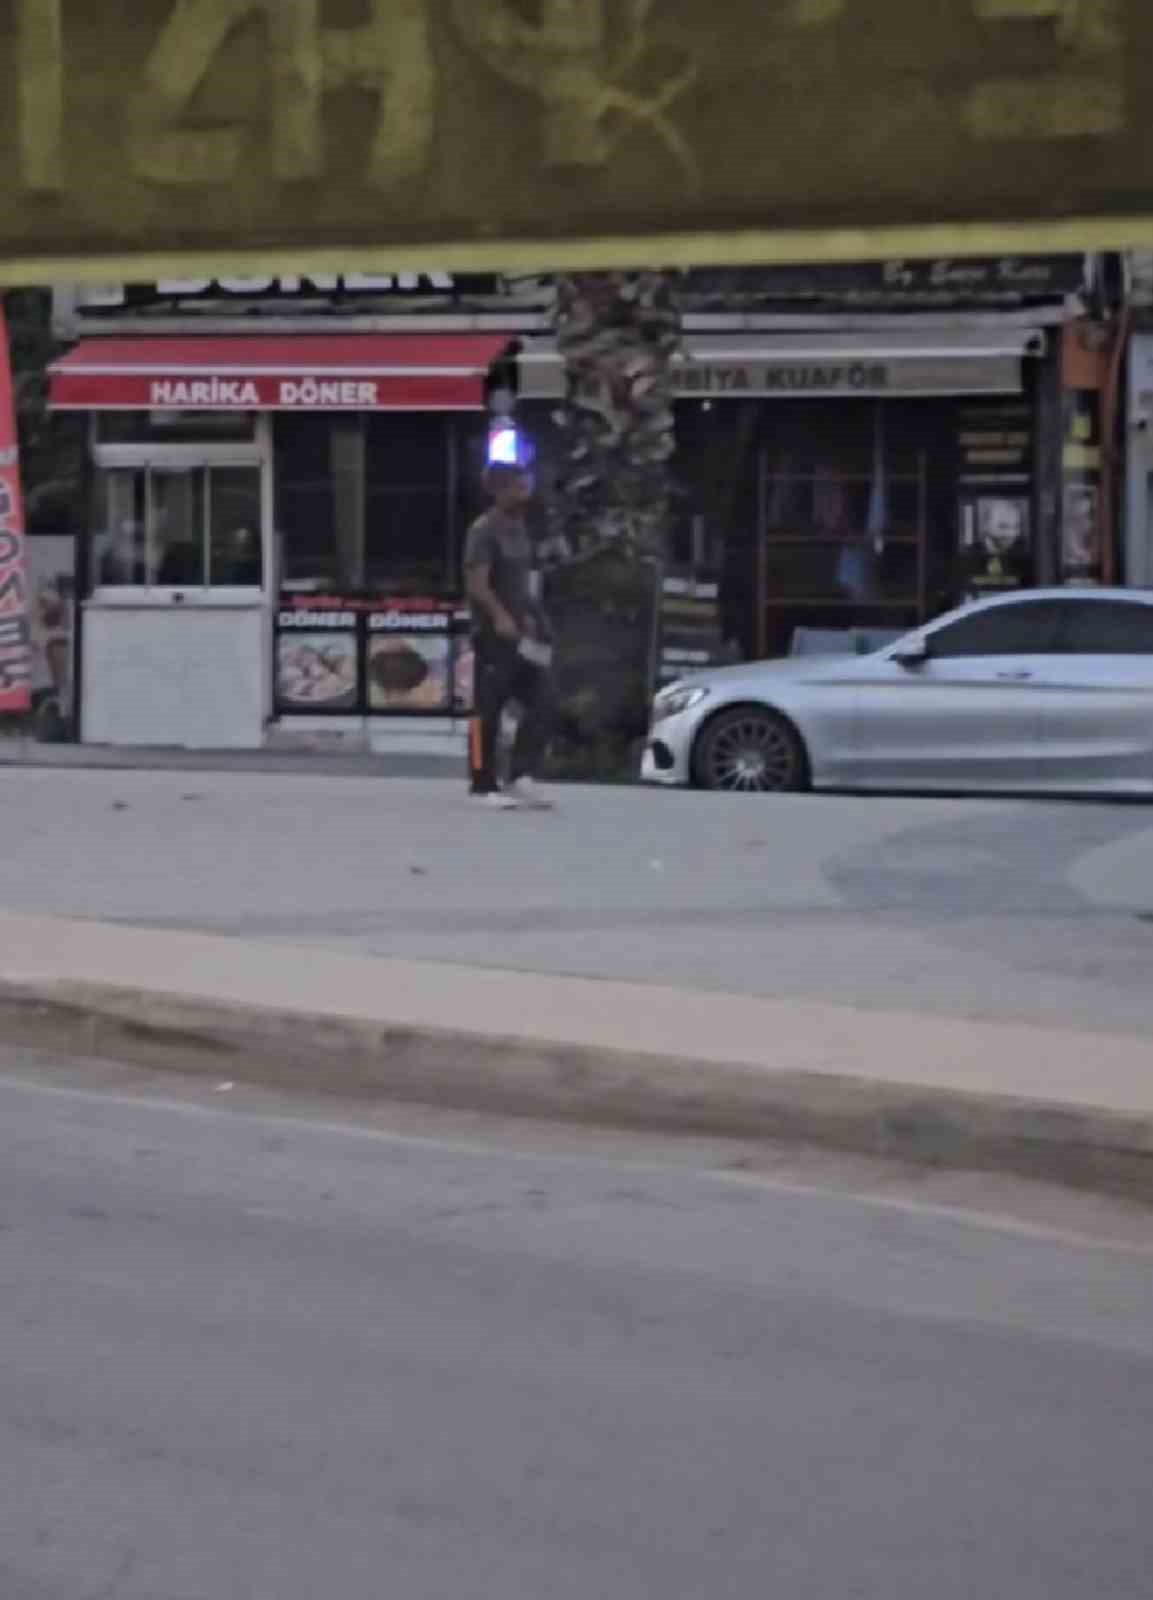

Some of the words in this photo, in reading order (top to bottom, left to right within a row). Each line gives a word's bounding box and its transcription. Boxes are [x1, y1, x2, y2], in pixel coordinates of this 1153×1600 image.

[765, 361, 887, 389] KUAFÖR
[151, 376, 259, 403] HARİKA
[278, 377, 378, 403] DÖNER
[279, 609, 355, 627] DÖNER
[369, 610, 448, 628] DÖNER
